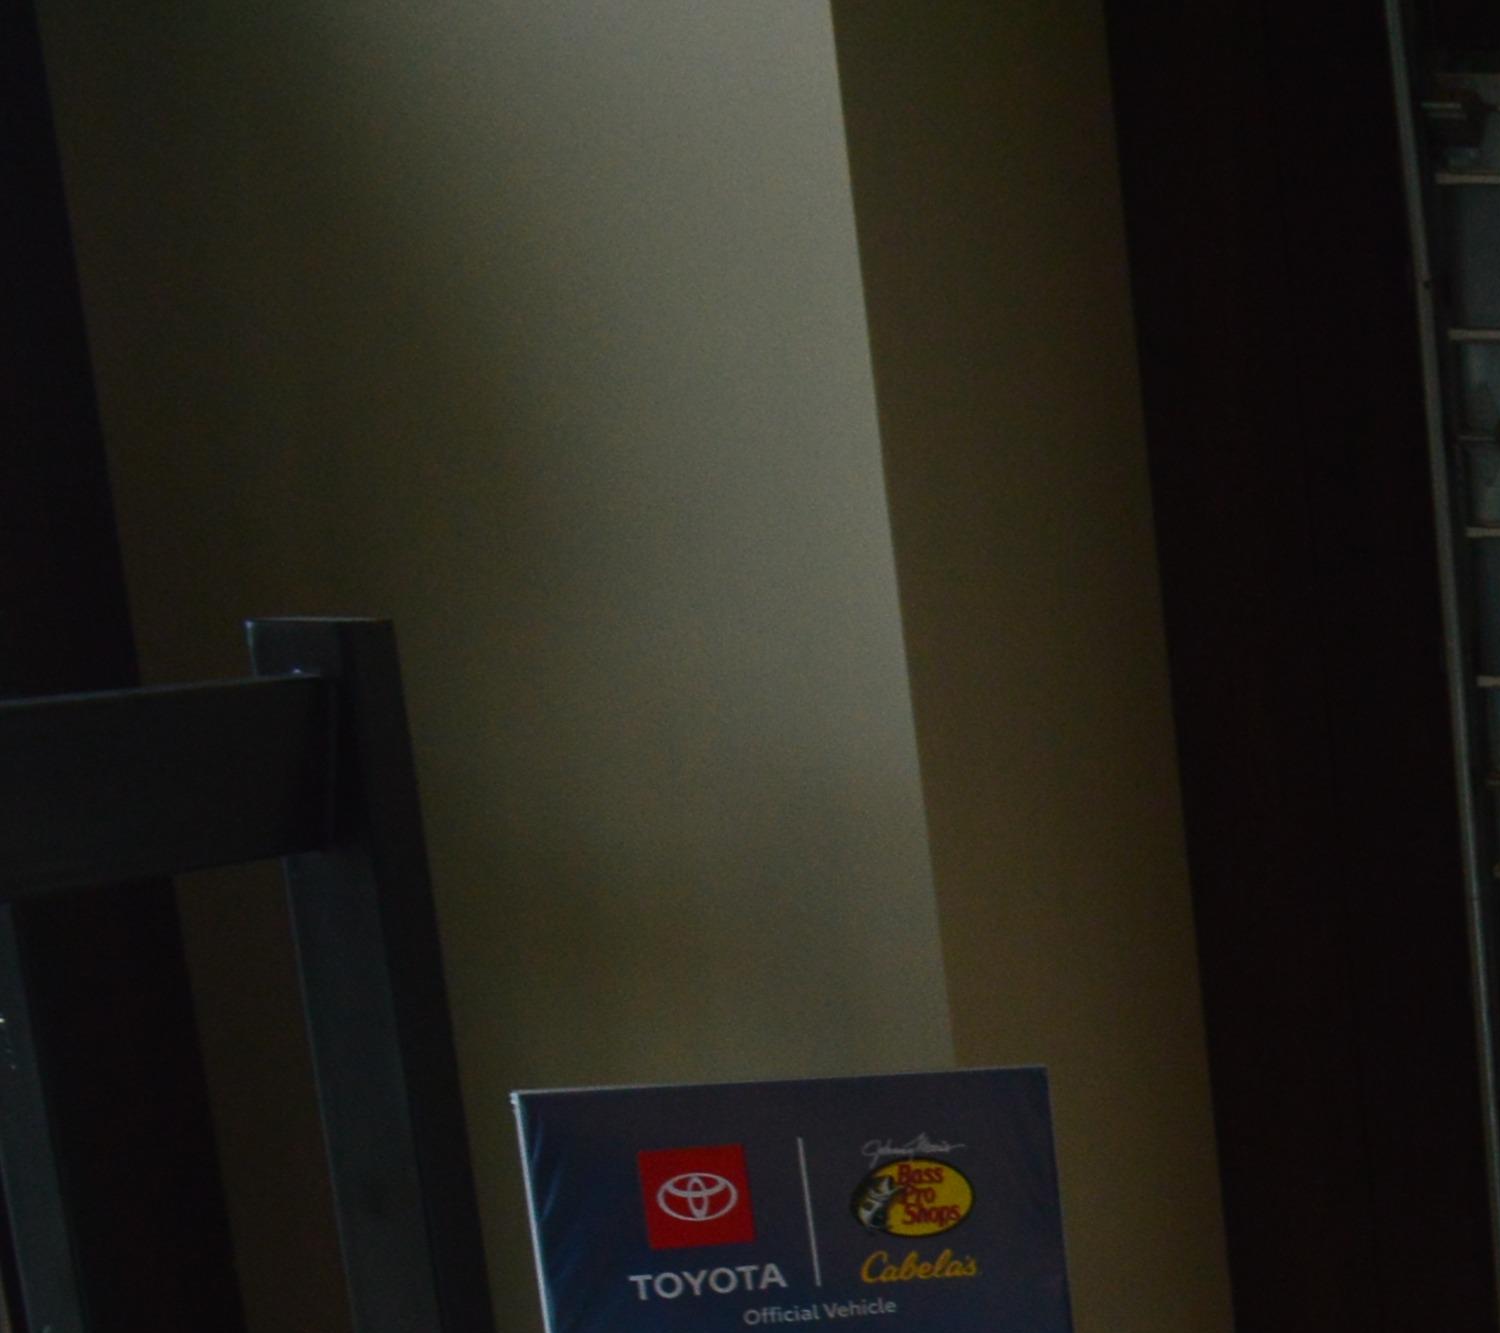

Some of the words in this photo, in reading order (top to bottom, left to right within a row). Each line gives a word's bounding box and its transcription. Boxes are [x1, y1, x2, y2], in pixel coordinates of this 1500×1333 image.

[896, 1164, 943, 1185] Bass
[899, 1185, 935, 1206] Pro
[902, 1204, 961, 1226] Shops
[860, 1249, 977, 1284] Cabela's
[628, 1263, 788, 1300] TOYOTA
[743, 1304, 820, 1326] Official
[823, 1298, 897, 1320] Vehicle
